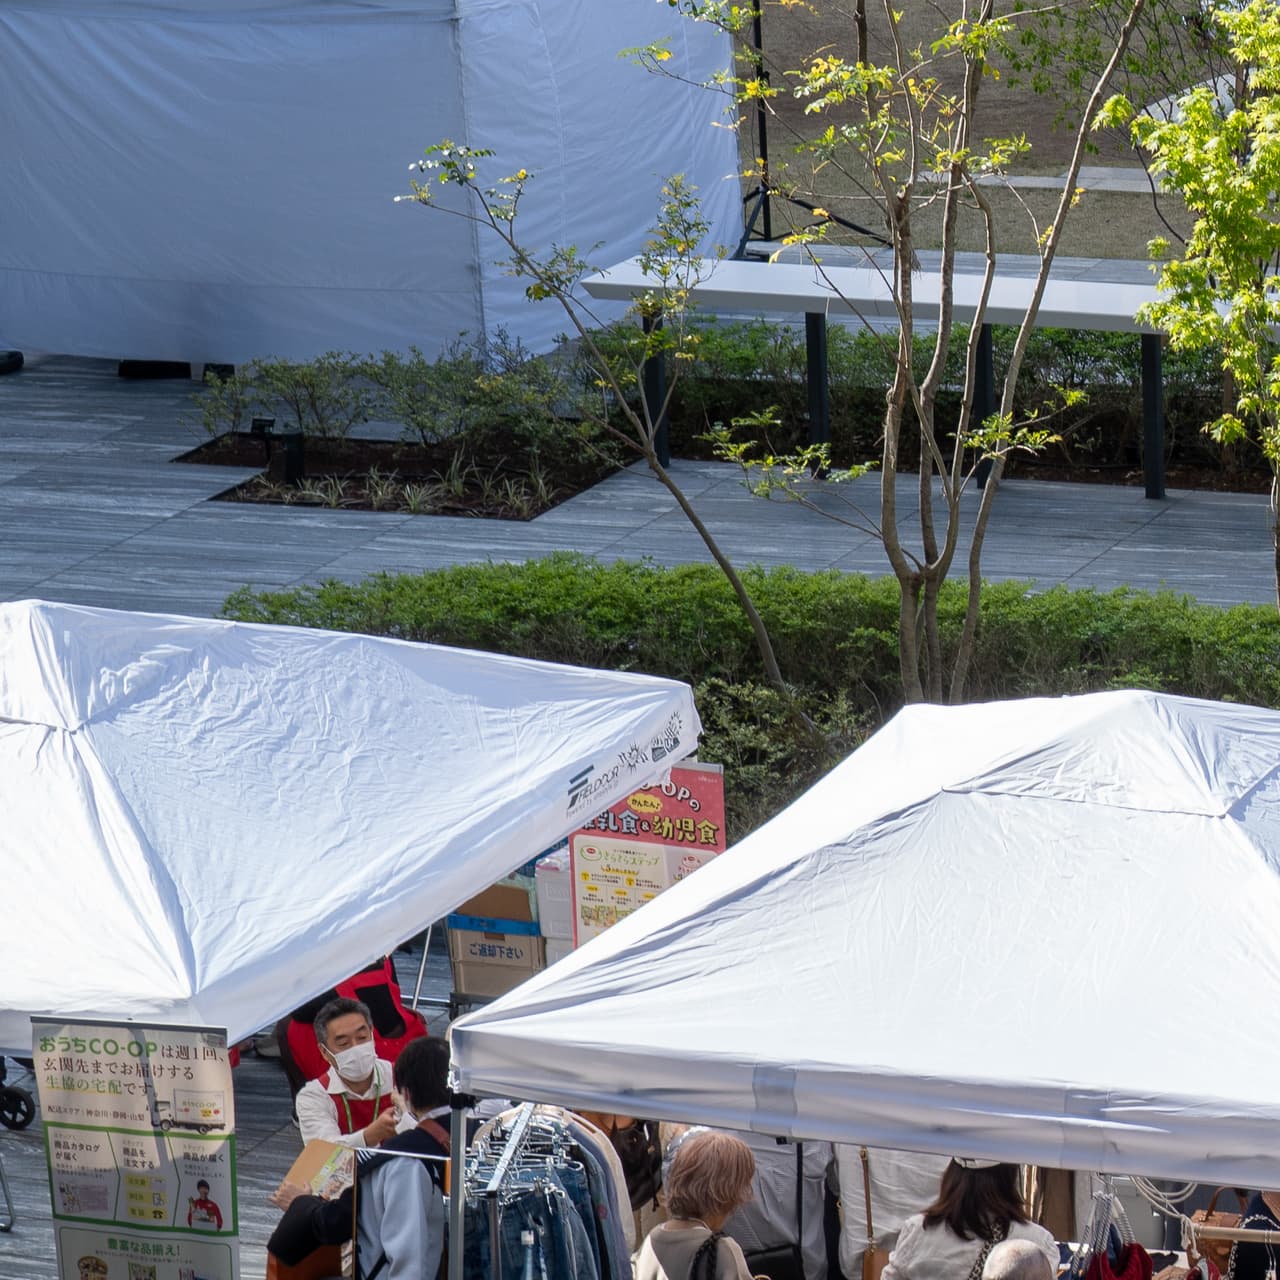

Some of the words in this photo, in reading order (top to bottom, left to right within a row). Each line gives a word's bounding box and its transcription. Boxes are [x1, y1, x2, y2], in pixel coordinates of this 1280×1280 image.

[470, 943, 524, 960] ご返却下さい
[43, 1056, 195, 1081] 玄関先までお届けする
[54, 1139, 101, 1153] 商品カタログ
[55, 1151, 78, 1162] が届く
[122, 1147, 146, 1158] 商品を
[183, 1151, 225, 1163] 商品が届く
[123, 1158, 155, 1170] 注文する
